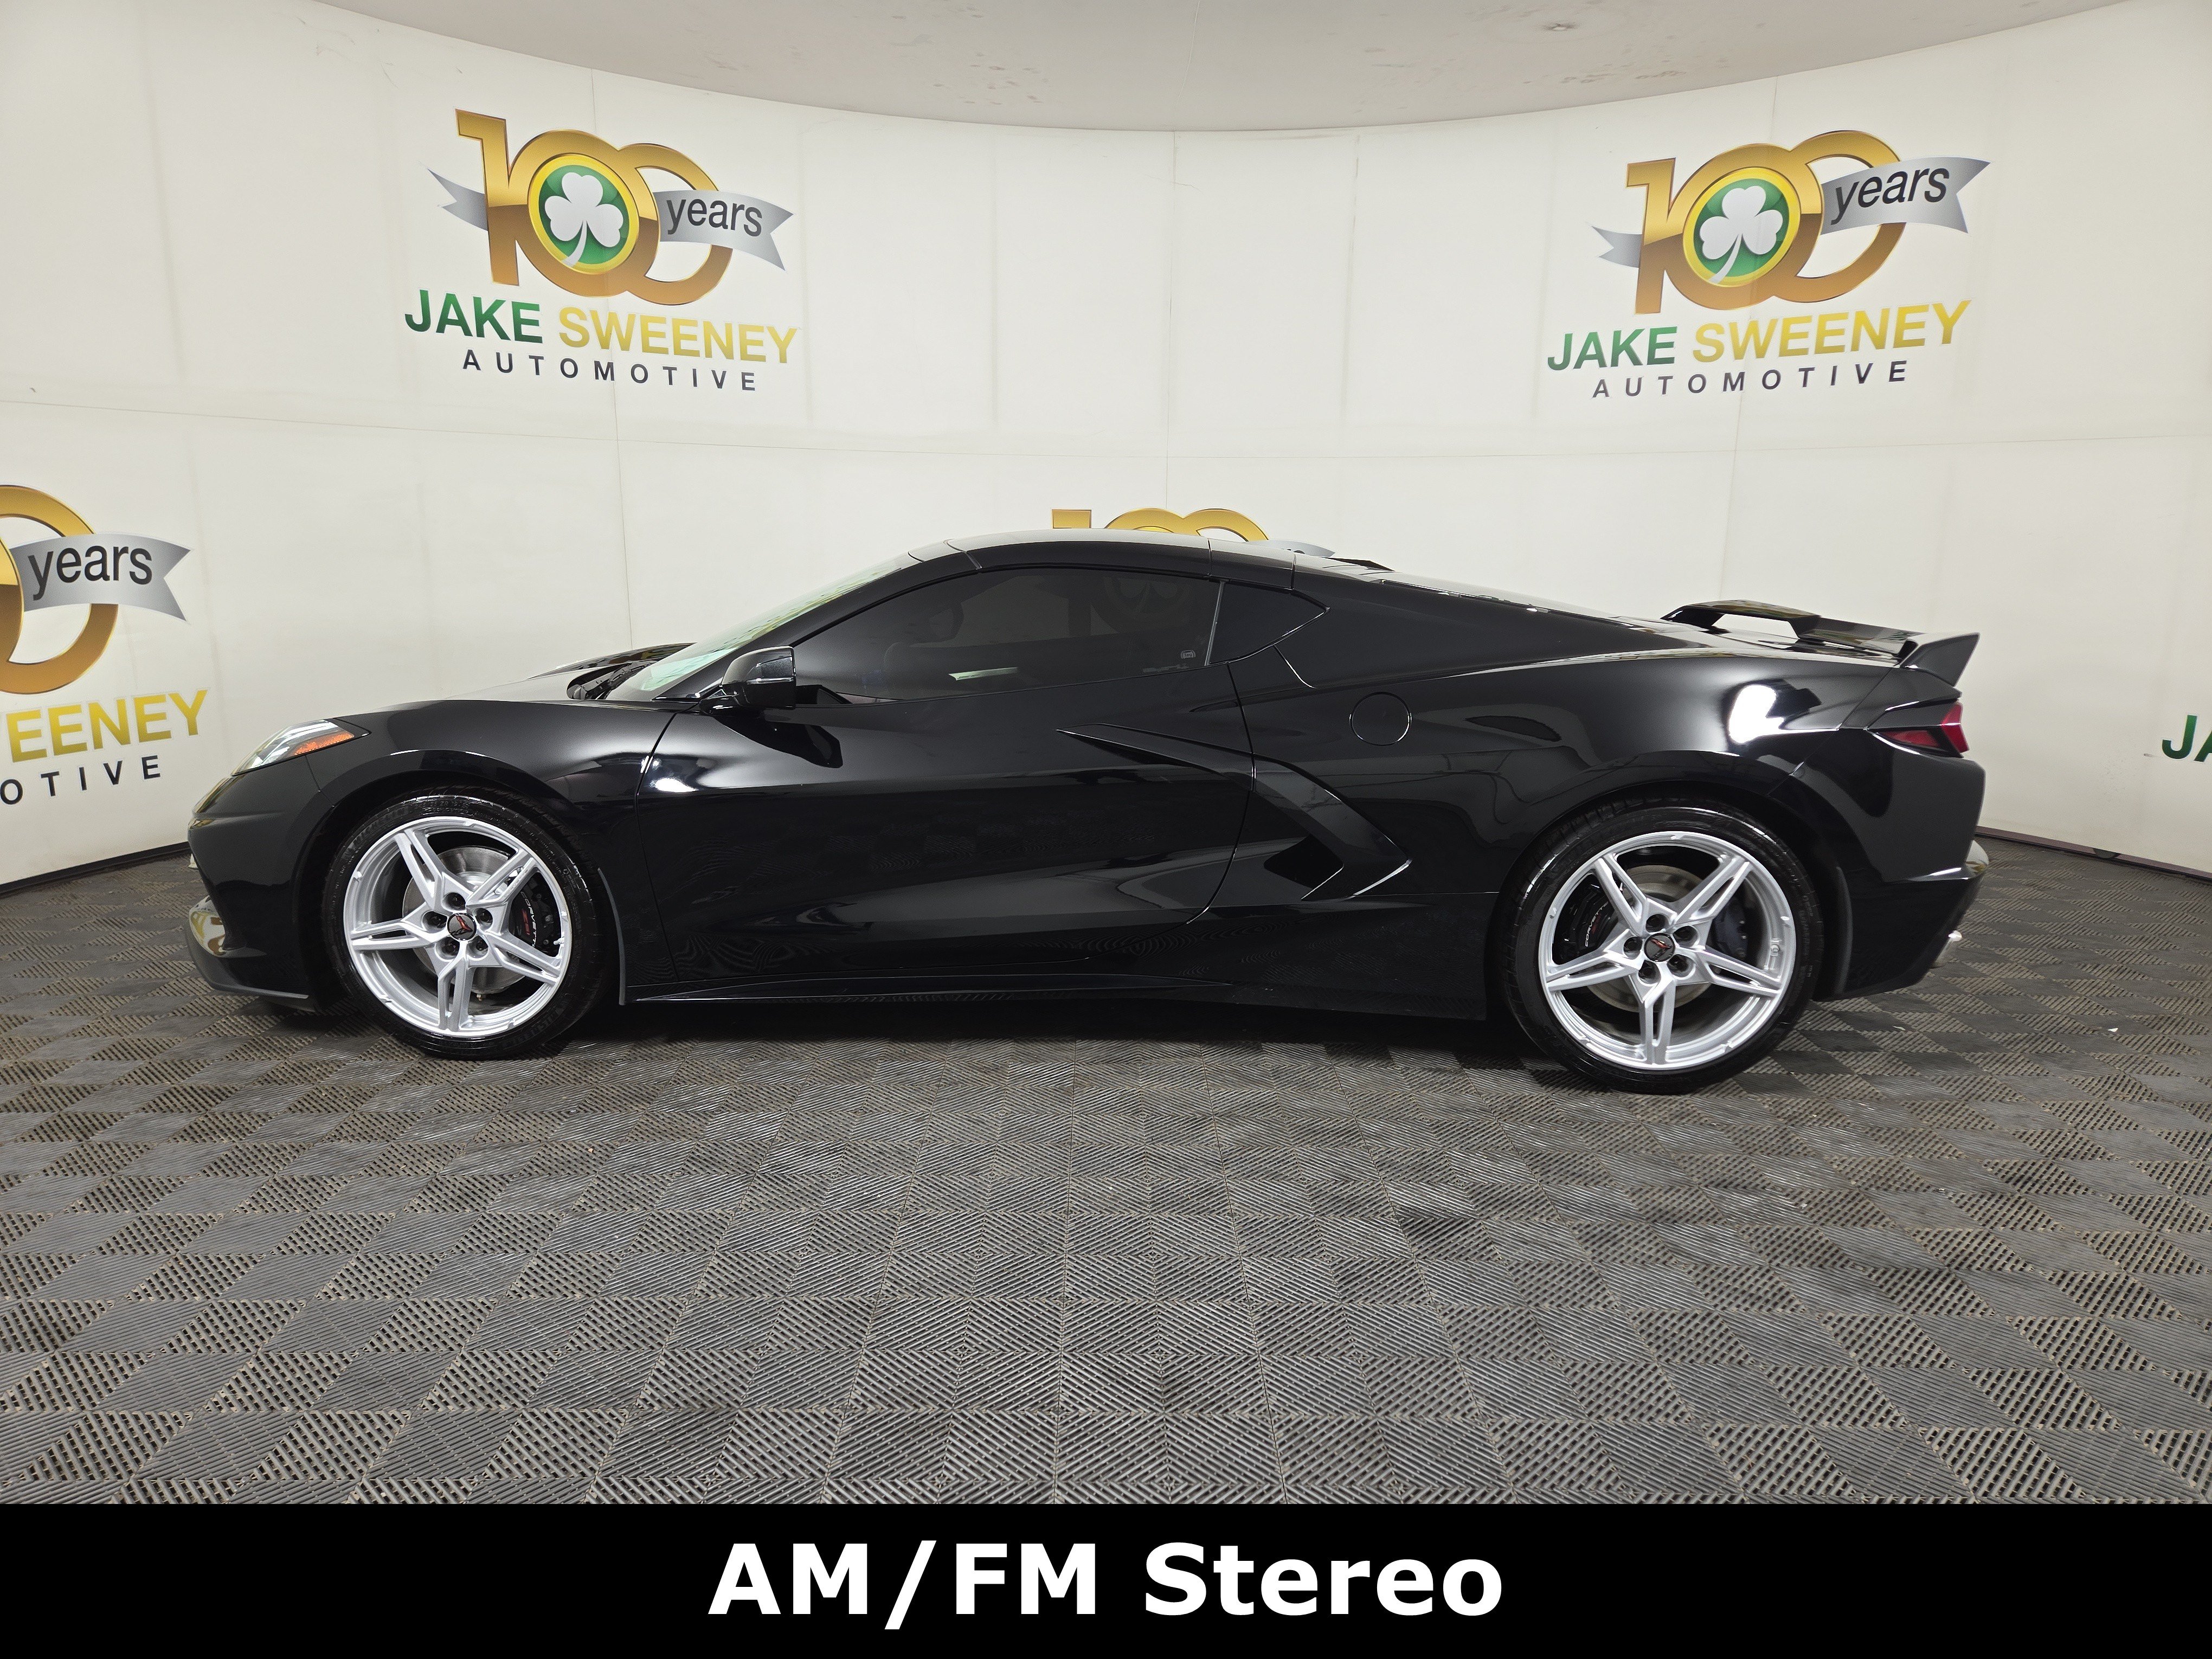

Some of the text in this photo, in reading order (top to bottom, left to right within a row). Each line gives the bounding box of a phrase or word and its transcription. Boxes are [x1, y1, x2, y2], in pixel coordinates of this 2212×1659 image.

[455, 109, 734, 306] 100
[667, 199, 763, 237] years
[1626, 130, 1907, 314] 100
[1831, 168, 1950, 224] years
[406, 290, 797, 363] JAKE SWEENEY
[1547, 300, 1970, 371] JAKE SWEENEY
[463, 350, 755, 391] AUTOMOTIVE
[1592, 360, 1907, 398] AUTOMOTIVE
[27, 545, 152, 601] years
